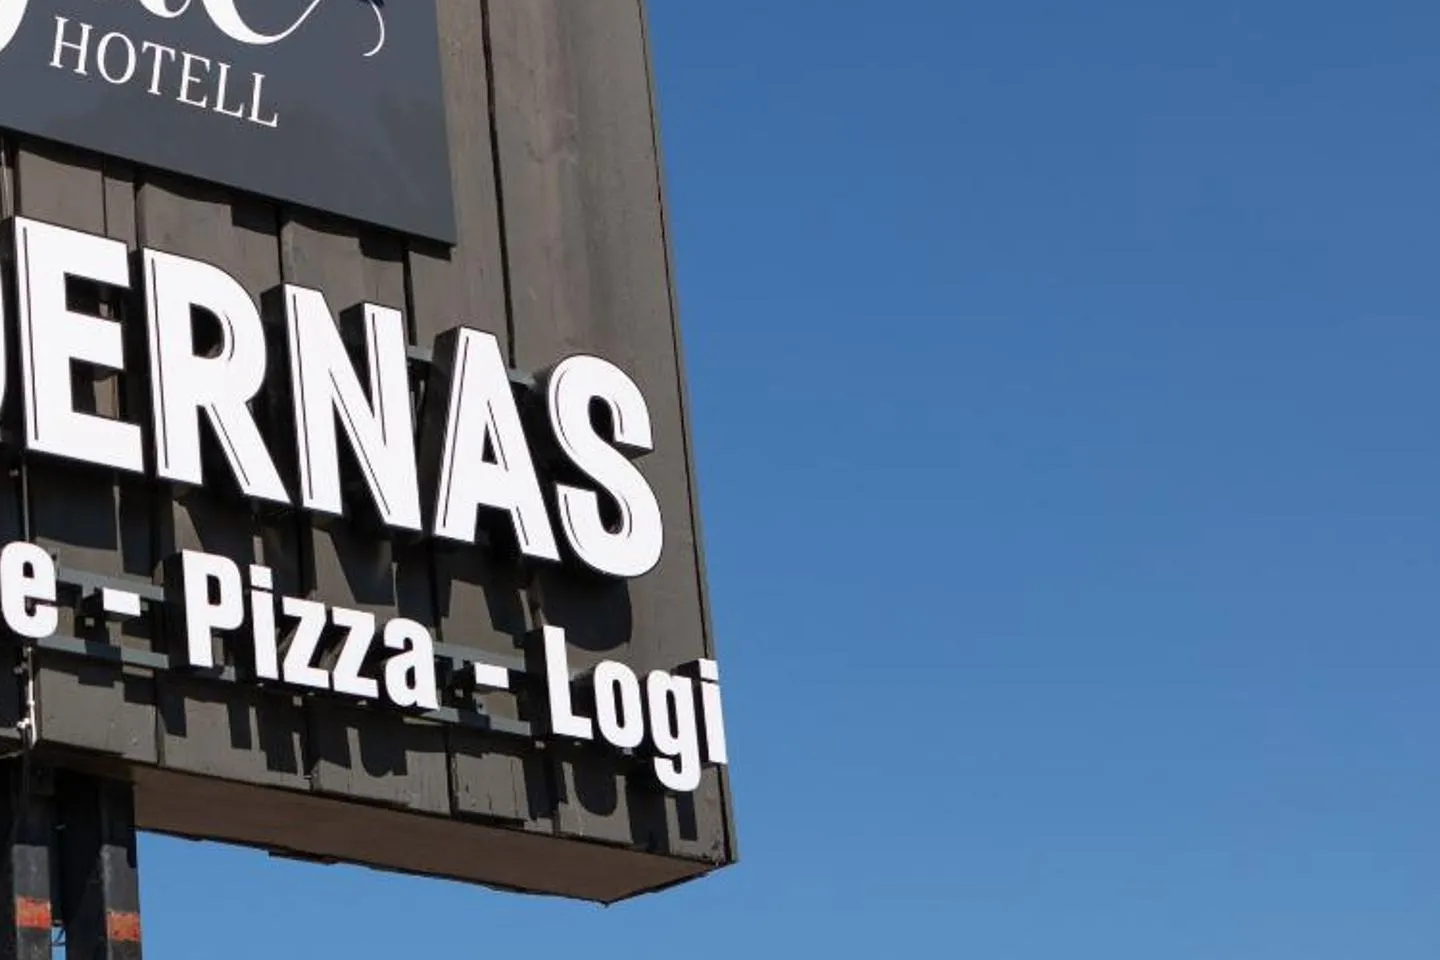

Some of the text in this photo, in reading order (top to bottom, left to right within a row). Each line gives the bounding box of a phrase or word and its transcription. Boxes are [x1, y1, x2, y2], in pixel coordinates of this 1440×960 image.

[51, 16, 280, 129] HOTELL
[181, 548, 440, 711] Pizza
[542, 624, 728, 792] Logi
